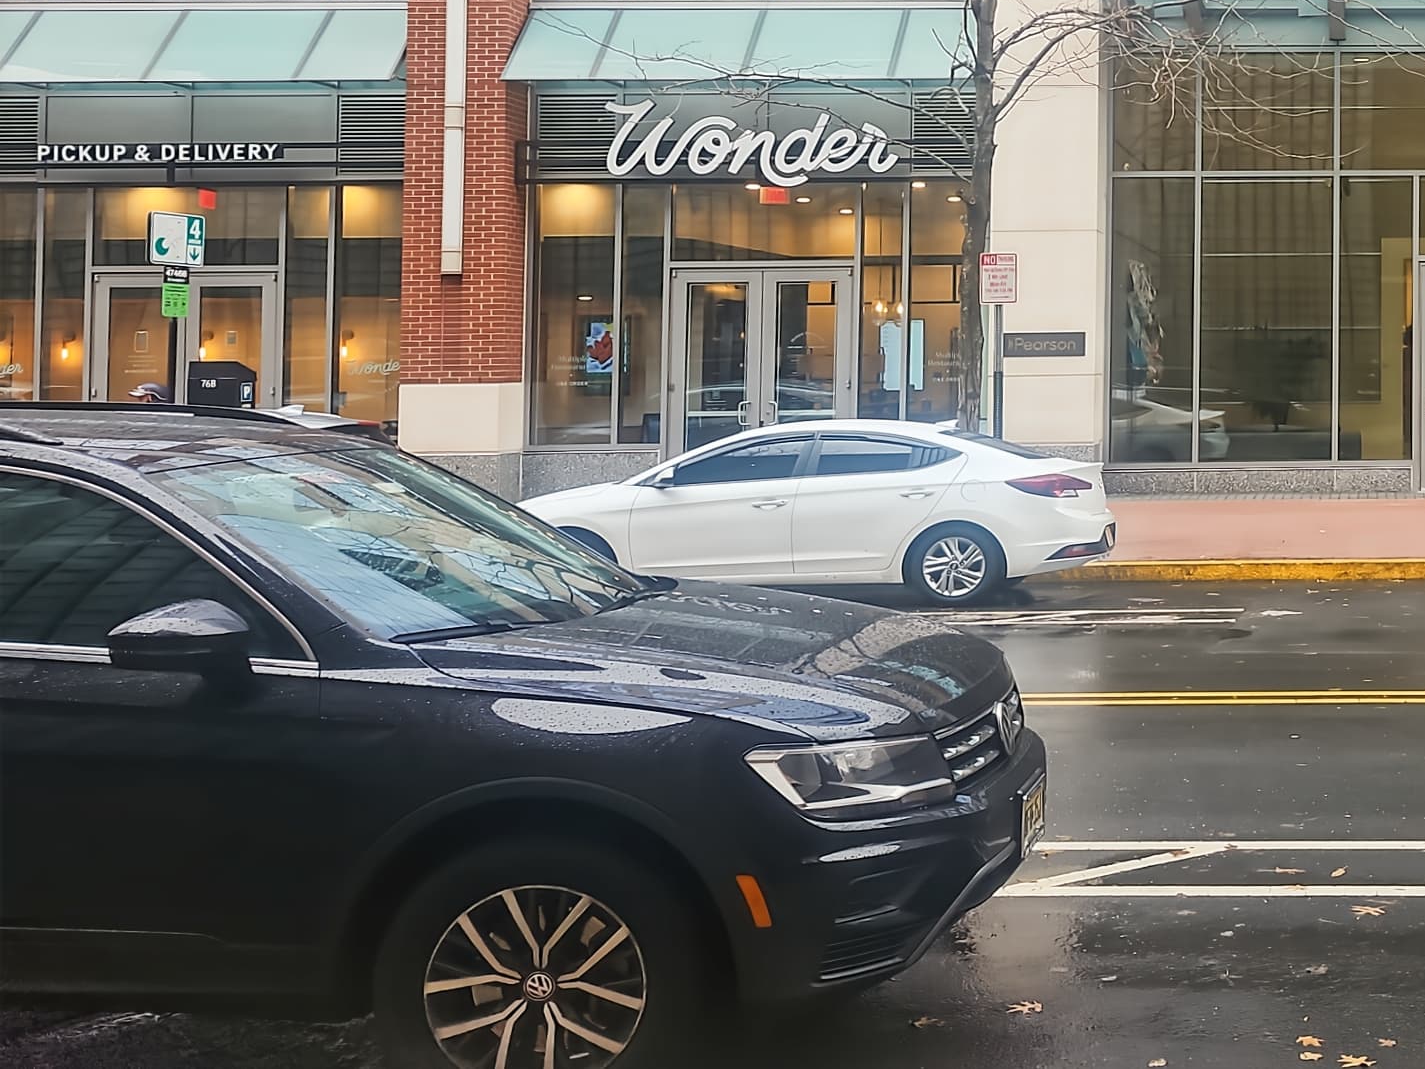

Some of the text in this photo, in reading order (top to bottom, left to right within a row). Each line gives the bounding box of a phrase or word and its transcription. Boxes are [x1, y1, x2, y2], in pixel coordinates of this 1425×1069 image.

[604, 99, 899, 187] Wonder
[37, 144, 278, 162] PICKUP & DELIVERY
[189, 219, 201, 240] 4
[983, 255, 996, 265] NO
[1014, 337, 1077, 352] Pearson
[200, 379, 217, 389] 76B
[243, 386, 251, 399] P
